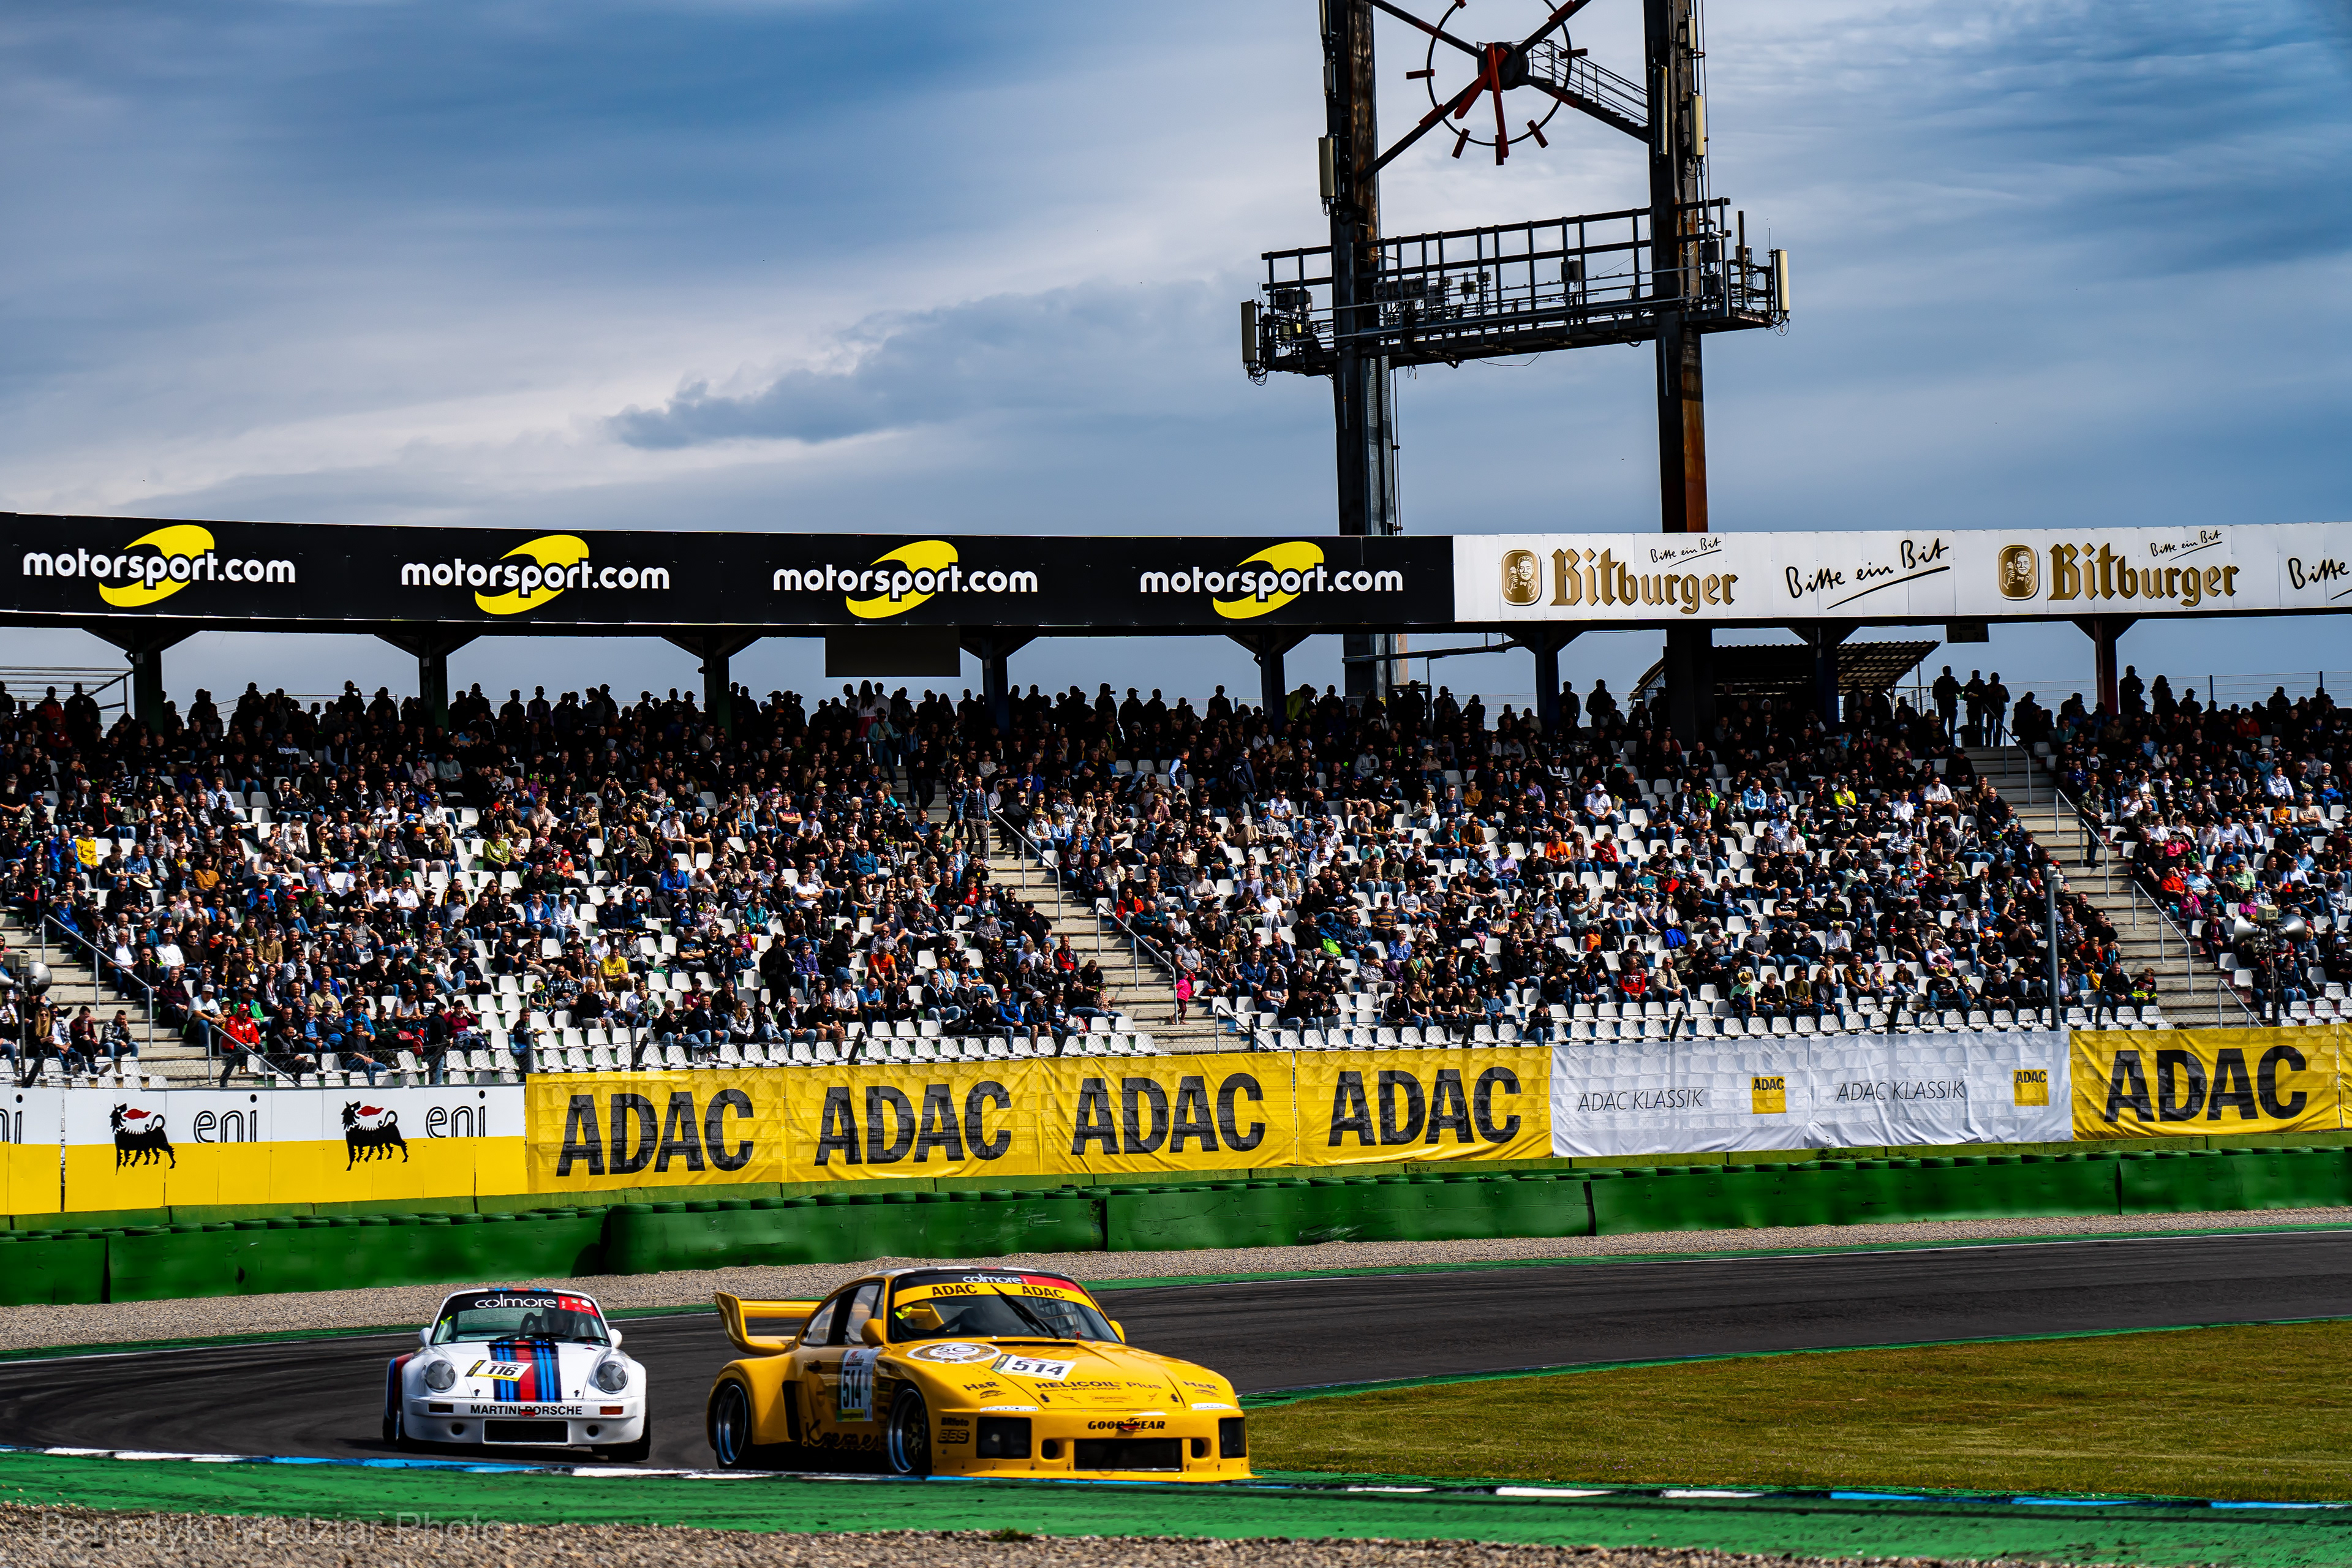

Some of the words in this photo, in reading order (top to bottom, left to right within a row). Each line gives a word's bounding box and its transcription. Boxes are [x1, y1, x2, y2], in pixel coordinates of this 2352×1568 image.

[1650, 548, 1677, 563] Bitte
[1681, 548, 1698, 556] ein
[1700, 537, 1722, 551] Bit
[2150, 542, 2177, 557] Bitte
[2181, 540, 2198, 550] ein
[2200, 530, 2222, 545] Bit
[23, 549, 296, 587] motorsport.com
[401, 556, 669, 595] motorsport.com
[774, 564, 1038, 599] motorsport.com
[1140, 563, 1403, 599] motorsport.com
[1550, 548, 1739, 615] Bitburger
[1785, 566, 1845, 599] Bitte
[1856, 562, 1894, 582] ein
[1901, 538, 1950, 570] Bit
[2048, 542, 2241, 606] Bitburger
[2288, 557, 2350, 590] Bitte
[1753, 1078, 1785, 1091] ADAC
[1836, 1082, 1887, 1101] ADAC
[1893, 1080, 1965, 1100] KLASSIK
[2015, 1071, 2048, 1084] ADAC
[2104, 1045, 2308, 1123] ADAC
[425, 1090, 486, 1137] eni
[1071, 1072, 1265, 1156] ADAC
[1328, 1066, 1521, 1147] ADAC
[1578, 1091, 1628, 1112] ADAC
[1633, 1088, 1704, 1110] KLASSIK
[194, 1094, 257, 1143] eni
[556, 1088, 754, 1177] ADAC
[814, 1080, 1012, 1166] ADAC
[932, 1284, 978, 1297] ADAC
[962, 1273, 1023, 1284] colmore
[1022, 1286, 1065, 1299] ADAC
[474, 1294, 557, 1308] colmore
[488, 1365, 519, 1376] 116
[1012, 1360, 1065, 1376] 514
[842, 1370, 862, 1408] 514
[962, 1381, 1000, 1391] H&R
[470, 1404, 521, 1415] MARTINI
[524, 1406, 582, 1415] PORSCHE
[938, 1429, 970, 1444] BBS
